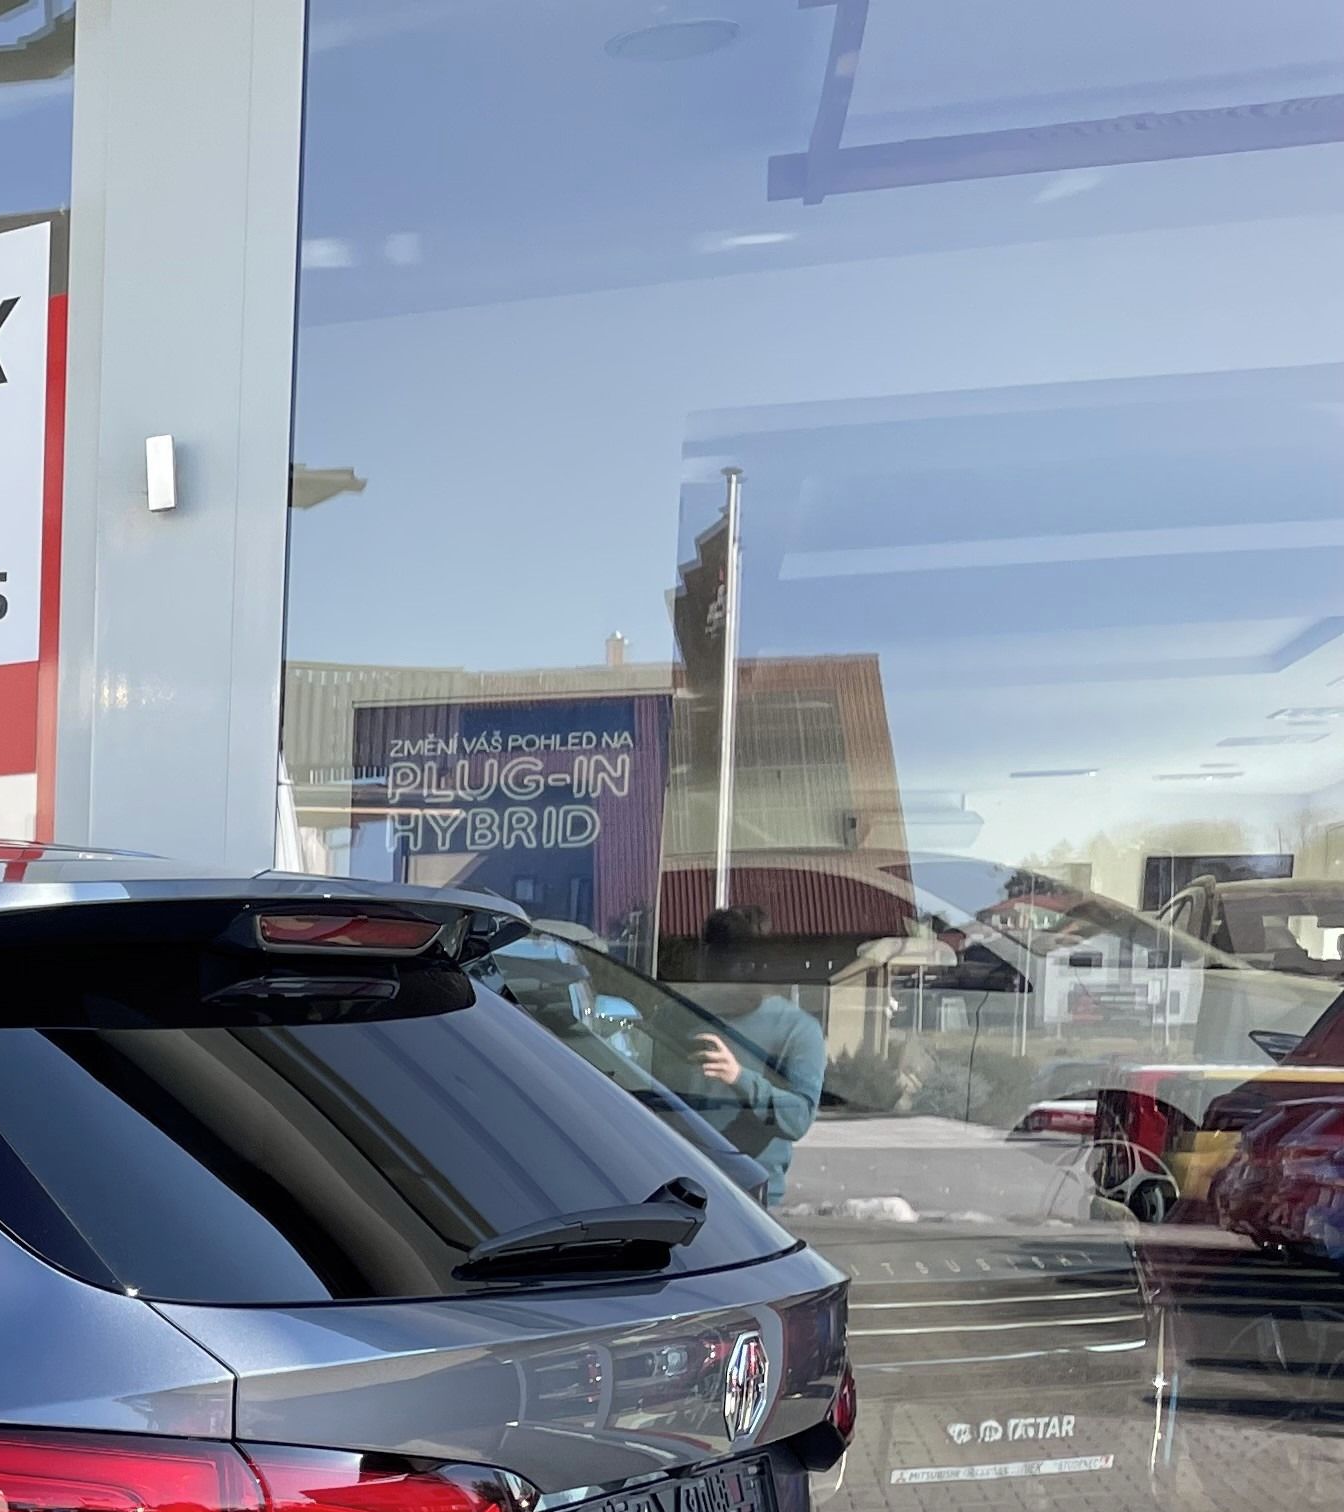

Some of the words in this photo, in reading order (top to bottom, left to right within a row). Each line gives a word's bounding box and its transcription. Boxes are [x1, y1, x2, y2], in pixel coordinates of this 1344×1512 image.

[390, 732, 458, 757] ZMĚNÍ
[462, 731, 502, 753] VÁŠ
[508, 731, 596, 752] POHLED
[602, 731, 633, 749] NA
[388, 754, 630, 804] PLUG-IN
[386, 805, 601, 851] HYBRID
